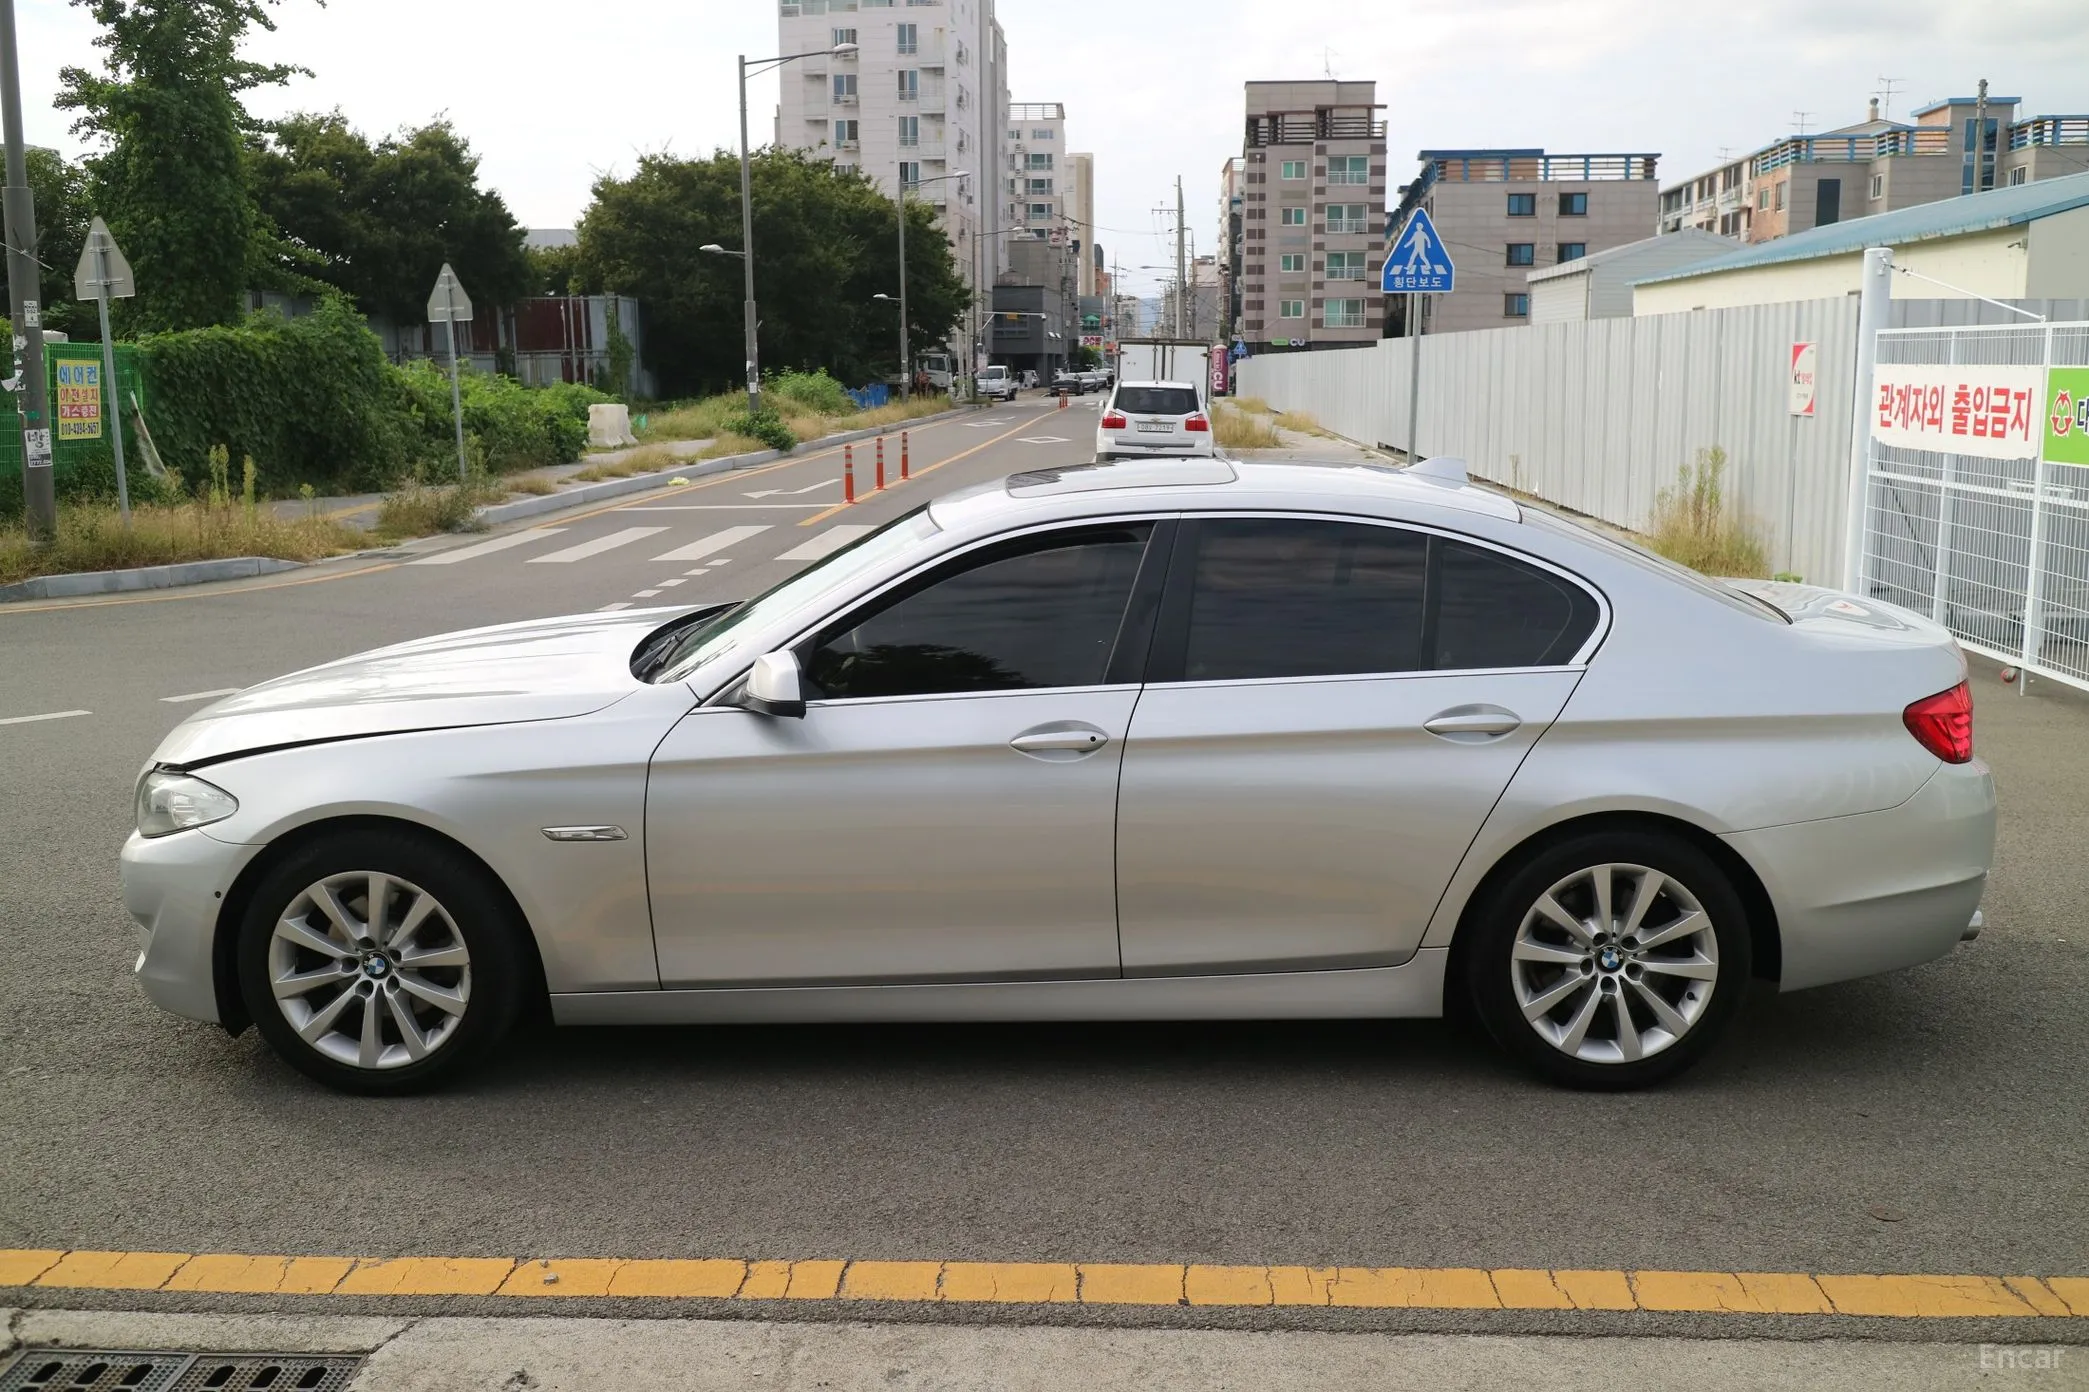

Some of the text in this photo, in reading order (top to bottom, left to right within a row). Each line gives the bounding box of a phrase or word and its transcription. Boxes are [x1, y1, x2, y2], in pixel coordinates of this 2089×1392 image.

[1393, 276, 1442, 289] 횡단보도
[1290, 338, 1306, 347] CU
[59, 366, 98, 385] 에어컨
[1213, 371, 1224, 390] CU
[61, 405, 97, 417] 가스충전
[1878, 383, 2033, 441] 관계자외 출입금지
